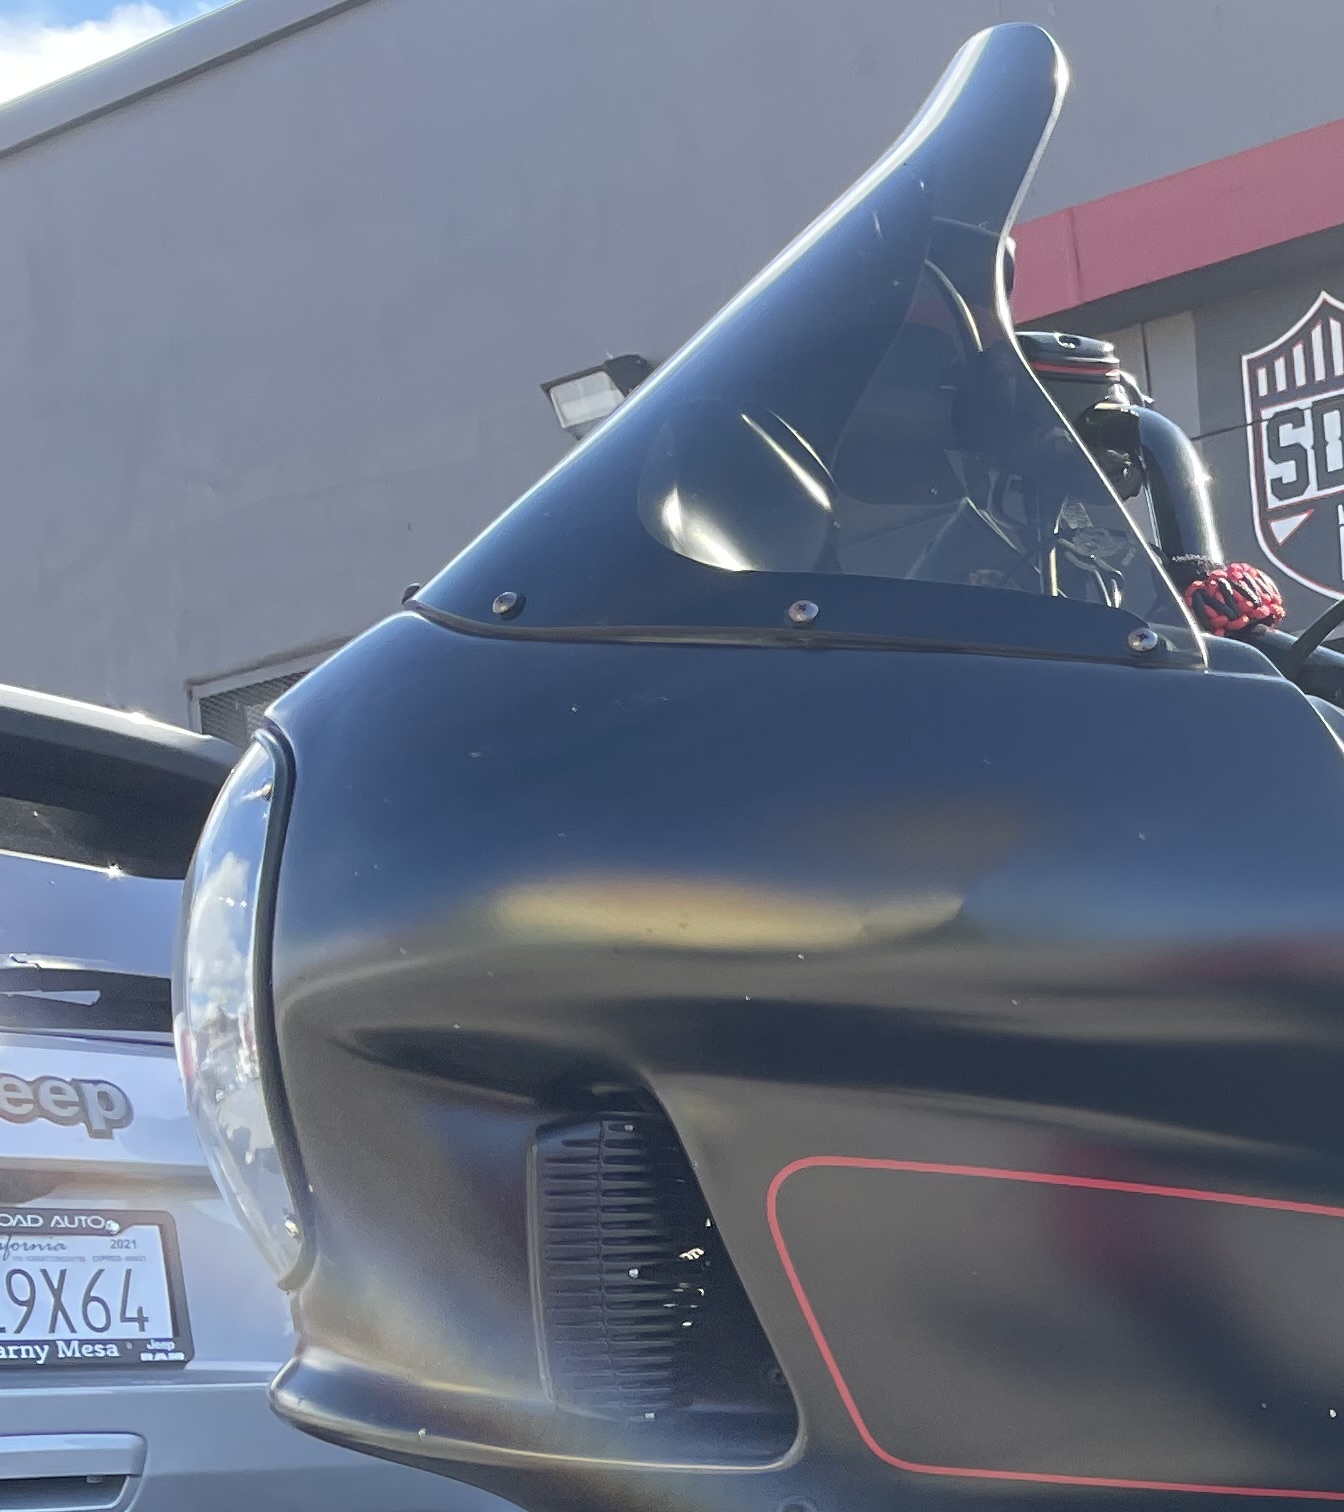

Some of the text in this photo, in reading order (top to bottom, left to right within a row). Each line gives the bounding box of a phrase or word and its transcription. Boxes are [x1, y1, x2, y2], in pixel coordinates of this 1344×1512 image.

[50, 1215, 106, 1229] AUTO
[110, 1239, 137, 1249] 2021
[0, 1269, 149, 1334] 9X64
[56, 1340, 120, 1358] Mesa
